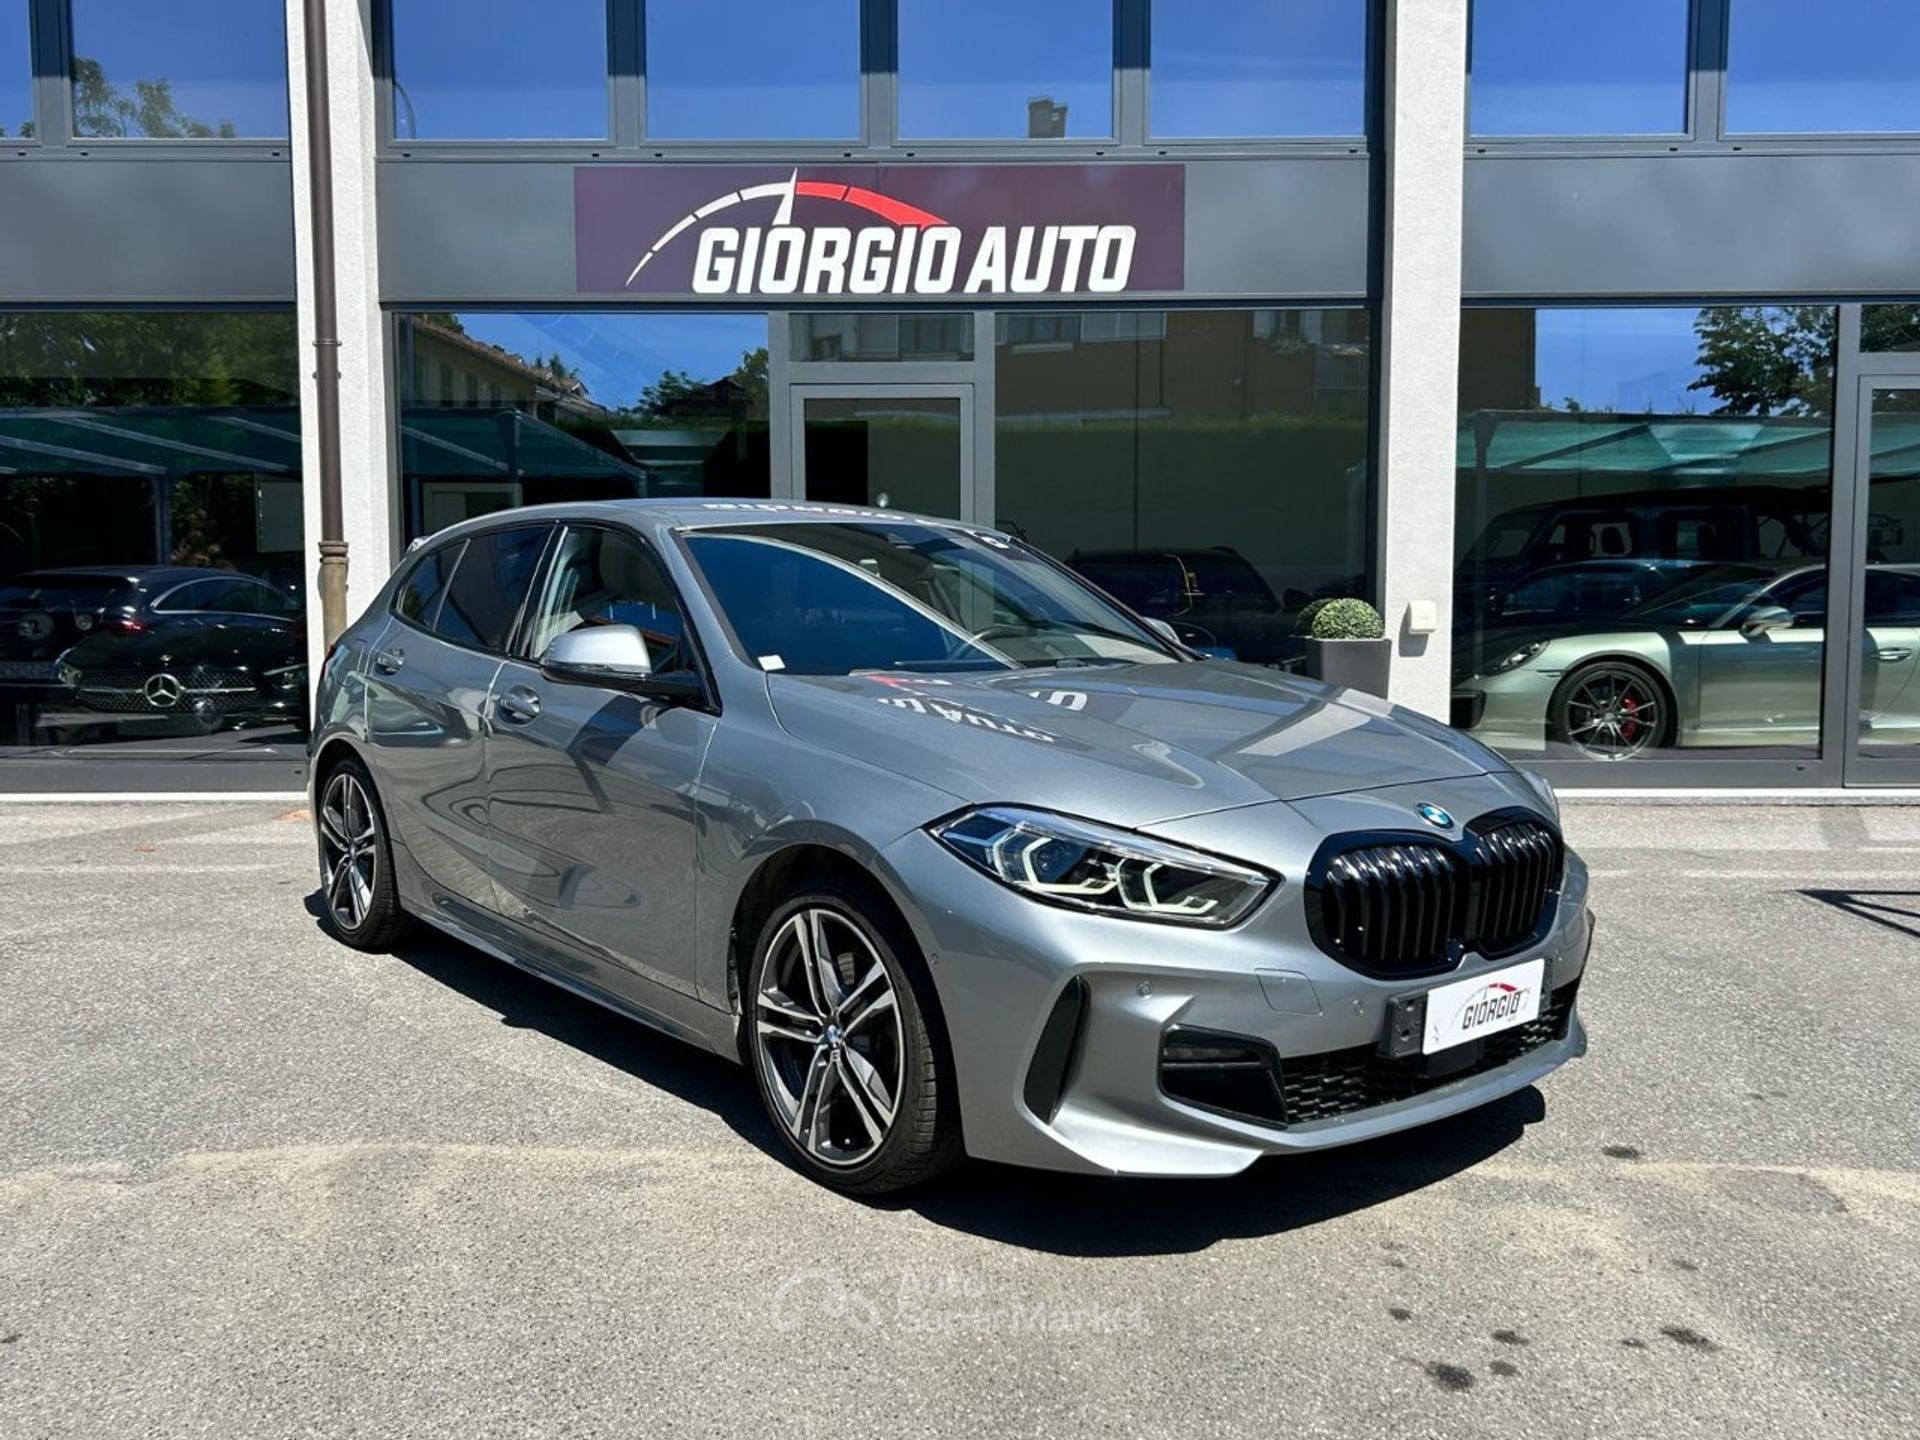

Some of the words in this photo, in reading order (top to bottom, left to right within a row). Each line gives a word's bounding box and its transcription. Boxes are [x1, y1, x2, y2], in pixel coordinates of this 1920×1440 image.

[692, 226, 962, 295] GIORGIO
[964, 225, 1137, 295] AUTO
[1462, 991, 1521, 1029] GIORGIO
